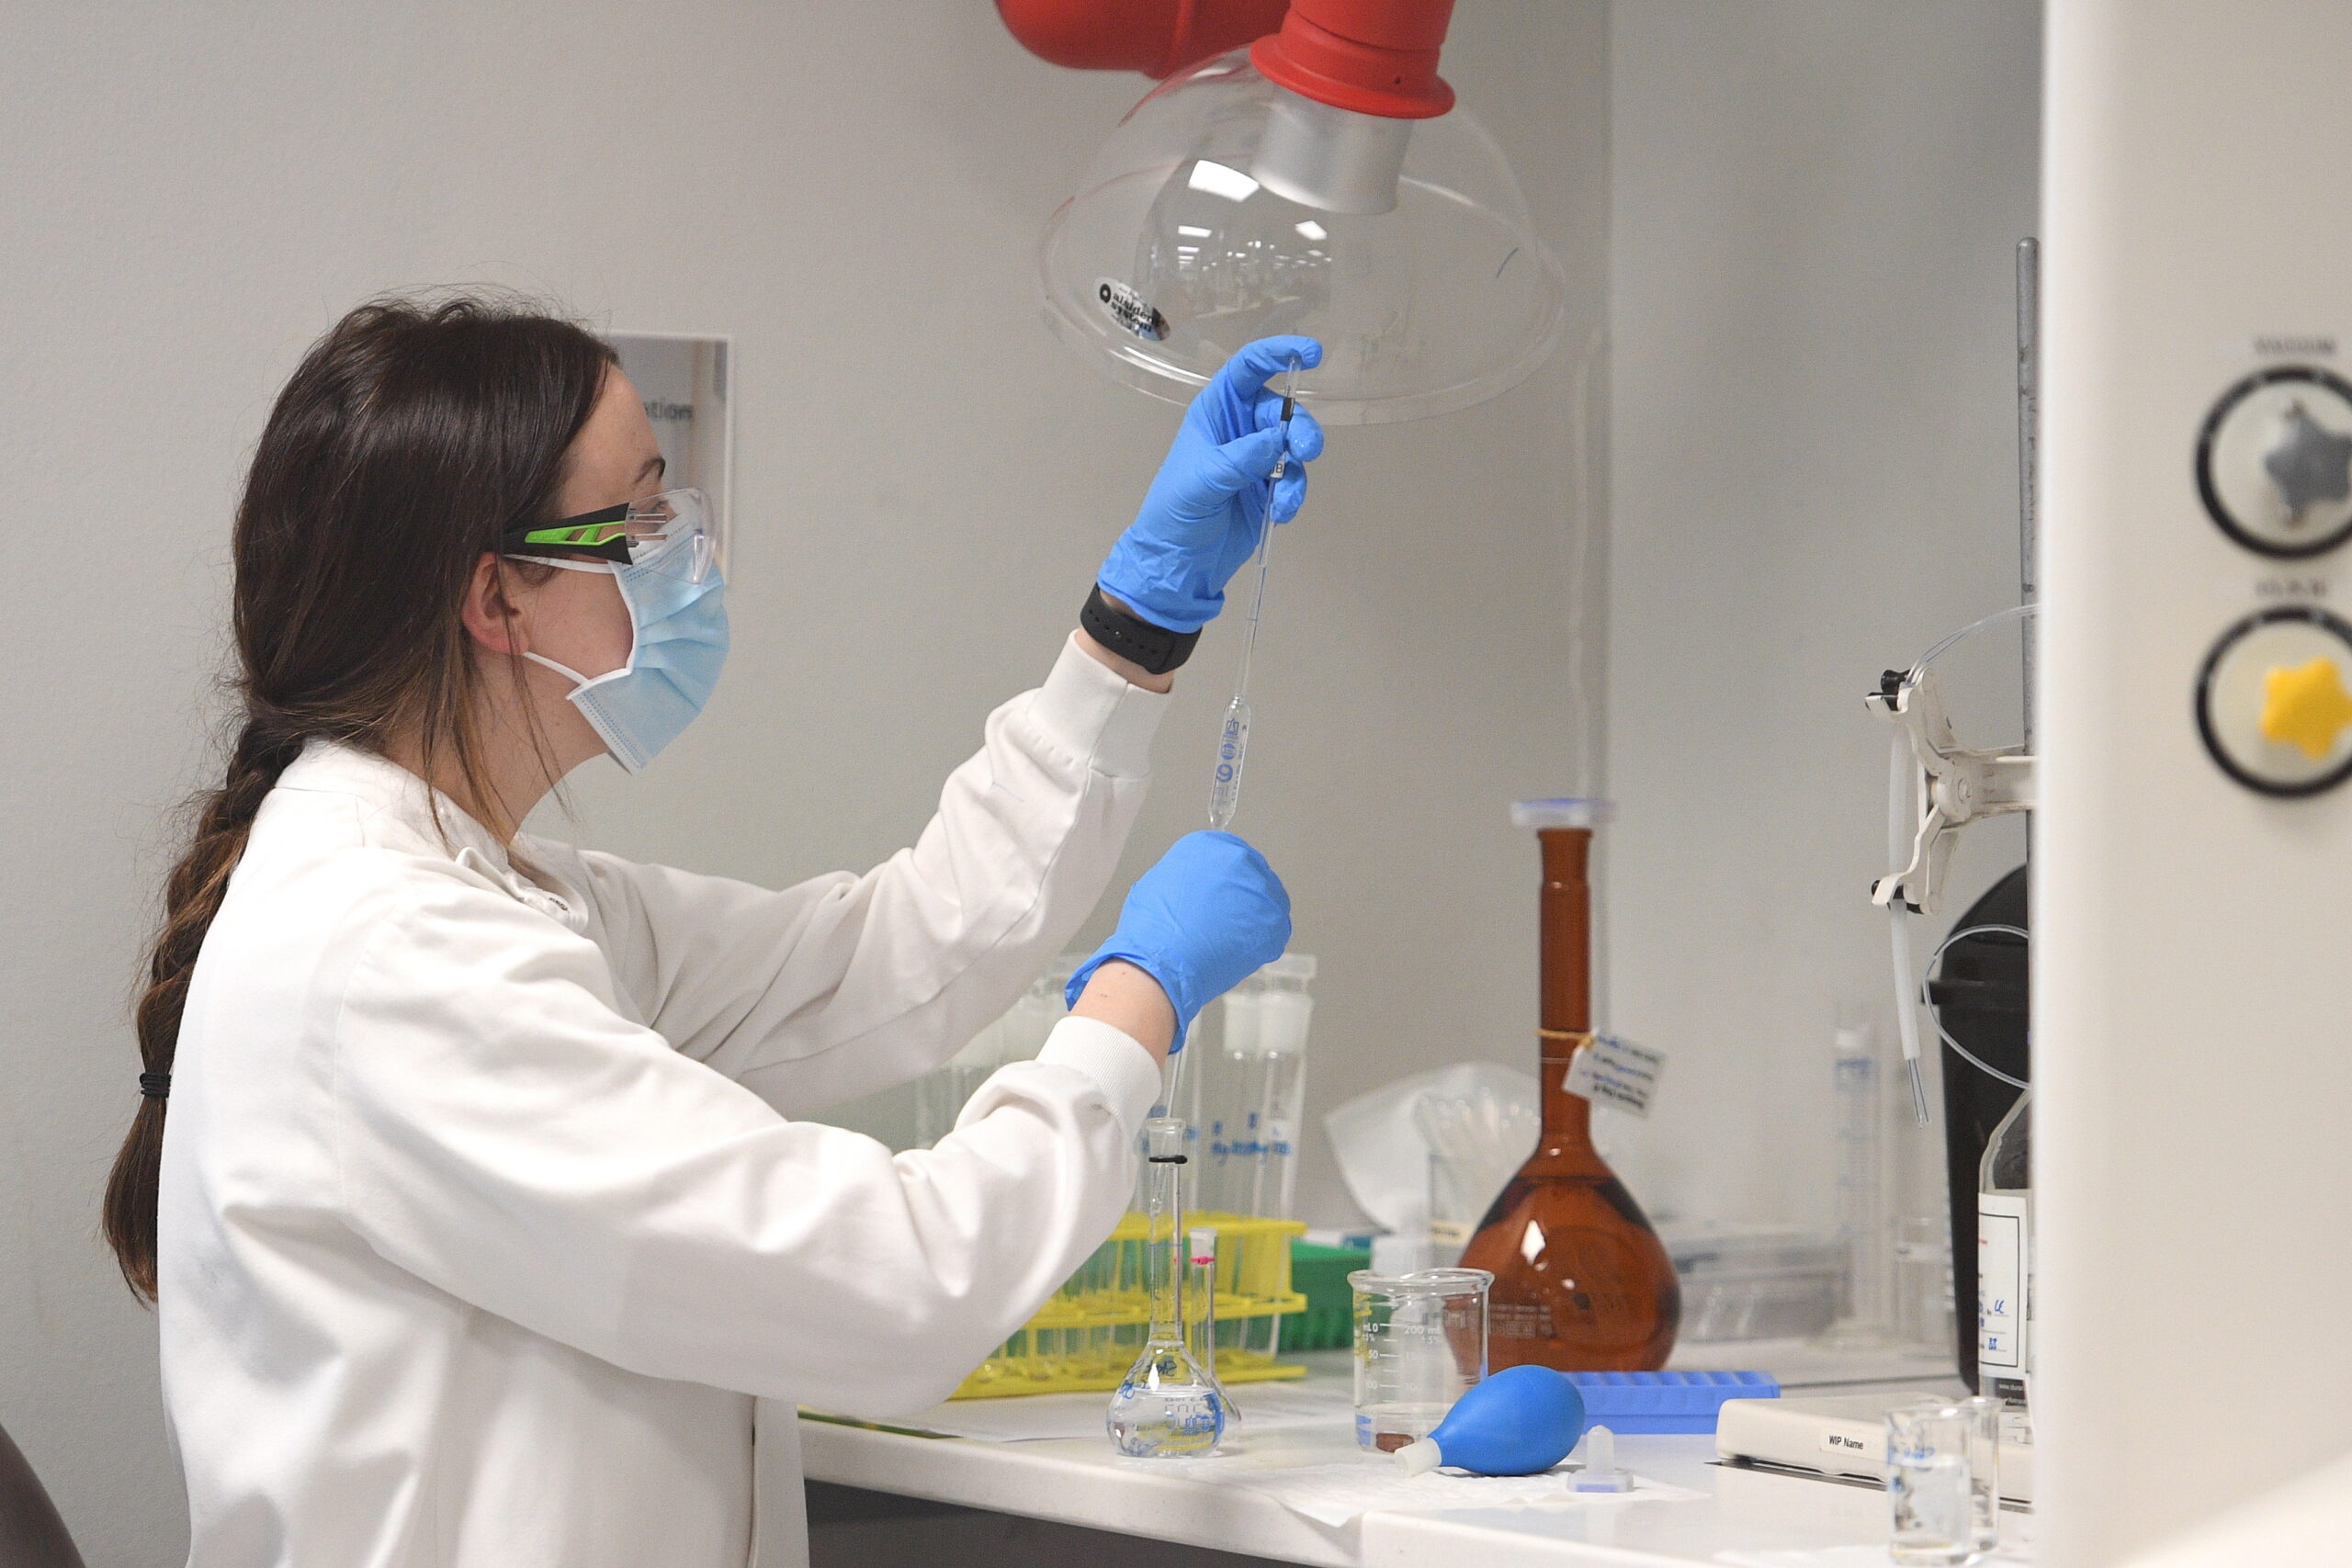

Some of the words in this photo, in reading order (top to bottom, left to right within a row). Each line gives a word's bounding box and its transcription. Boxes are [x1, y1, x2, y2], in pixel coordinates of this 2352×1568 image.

[644, 399, 694, 420] tion
[1404, 1325, 1424, 1335] 200
[1828, 1434, 1842, 1446] WIP
[1843, 1437, 1864, 1450] Name
